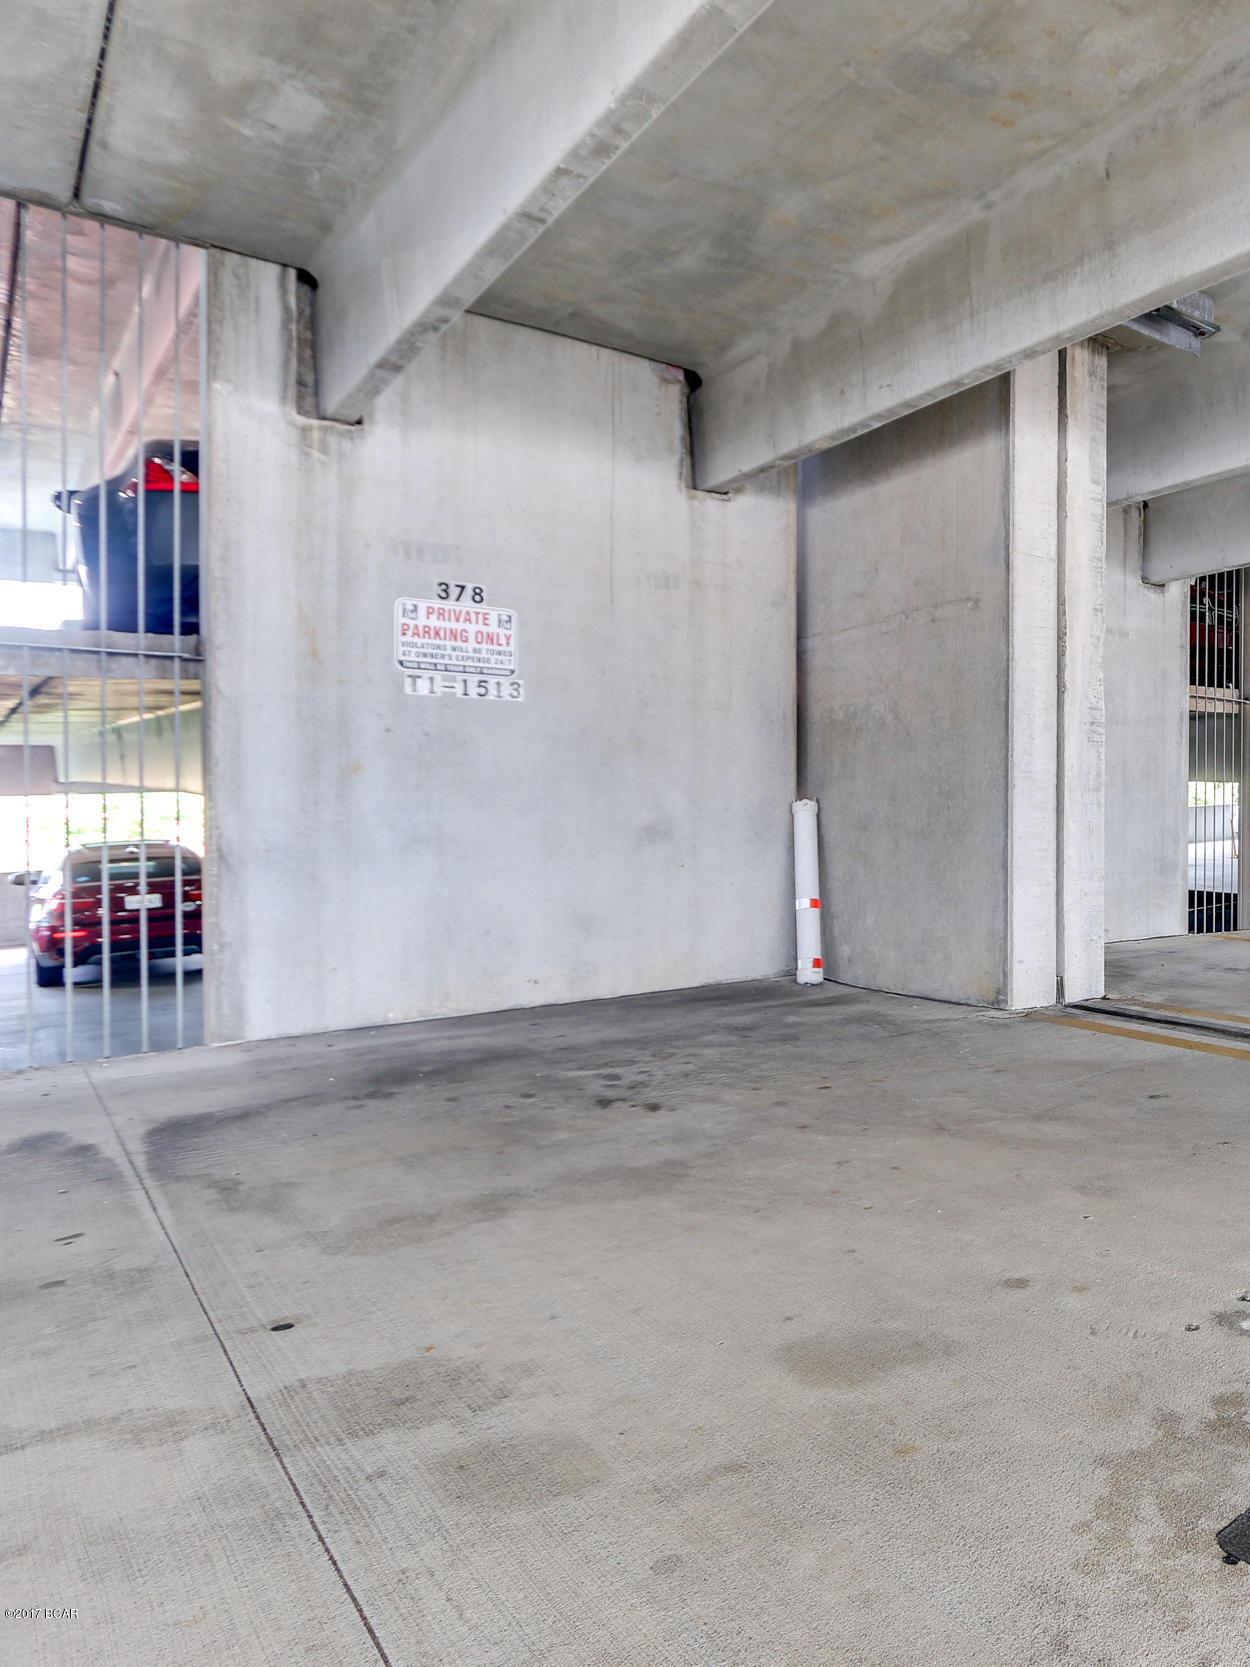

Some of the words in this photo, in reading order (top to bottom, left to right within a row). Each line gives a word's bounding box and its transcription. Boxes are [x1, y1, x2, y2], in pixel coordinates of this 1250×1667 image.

[437, 582, 484, 604] 378
[426, 605, 490, 626] PRIVATE
[401, 622, 469, 644] PARKING
[475, 630, 512, 647] ONLY
[400, 641, 447, 651] VIOLATORS
[450, 645, 469, 653] WILL
[472, 647, 483, 655] BE
[485, 648, 513, 657] TOWED
[414, 651, 452, 661] OWNER'S
[455, 654, 491, 664] EXPENSE
[406, 674, 521, 699] T1-1513
